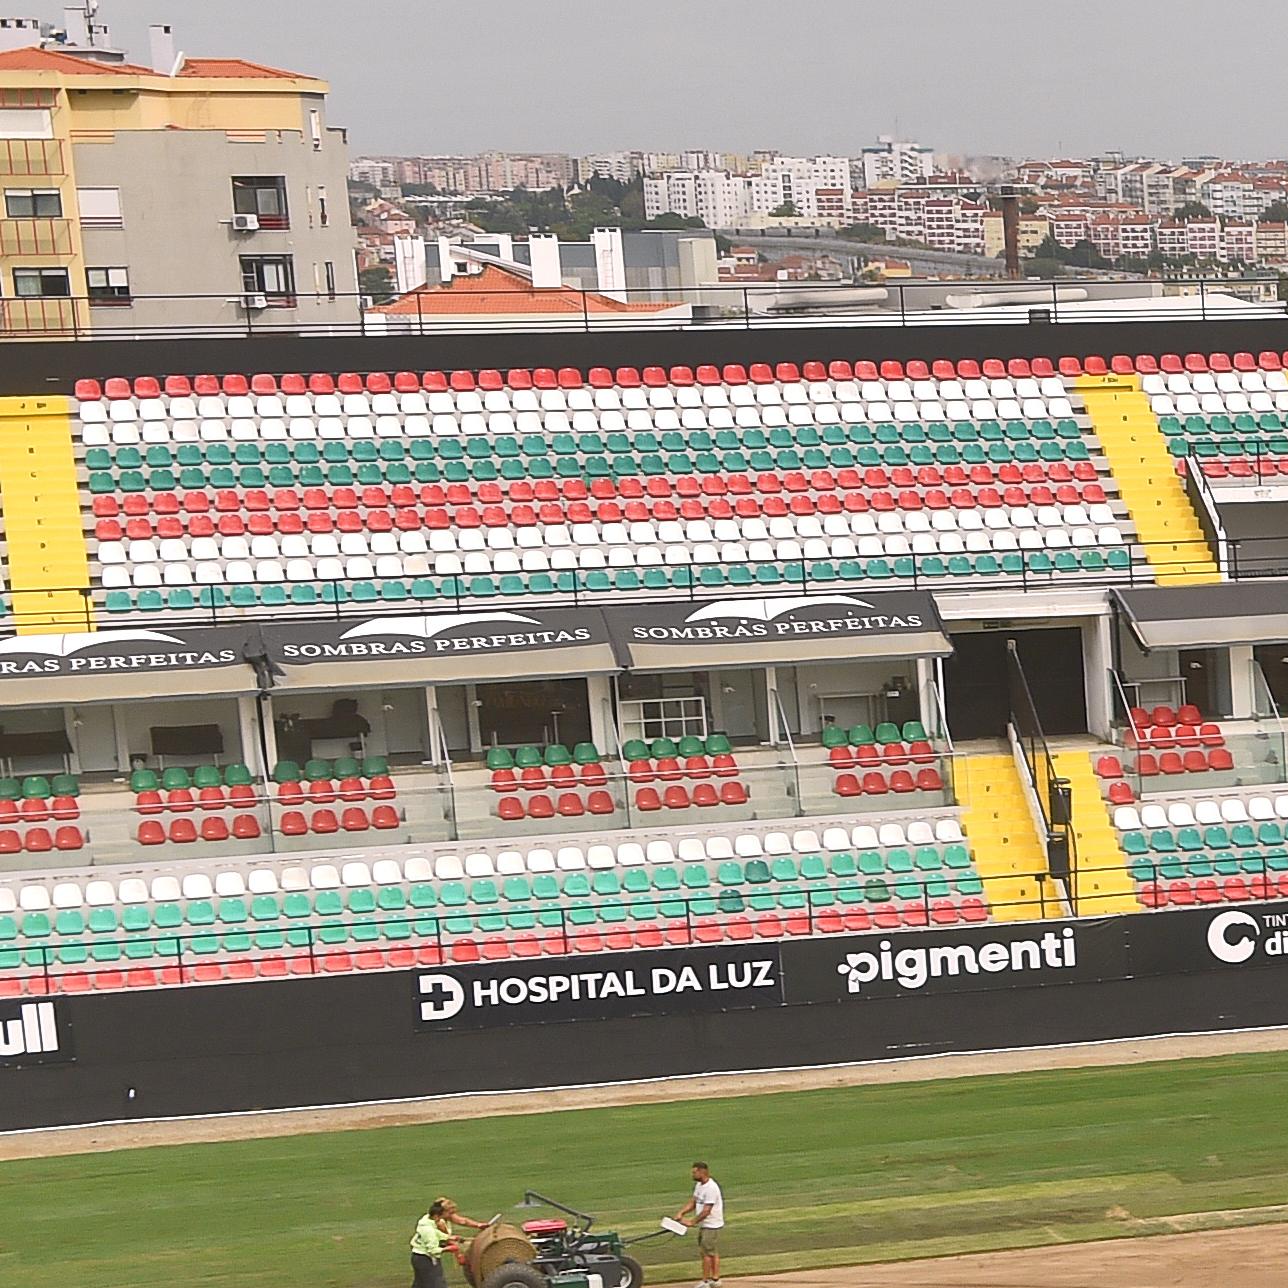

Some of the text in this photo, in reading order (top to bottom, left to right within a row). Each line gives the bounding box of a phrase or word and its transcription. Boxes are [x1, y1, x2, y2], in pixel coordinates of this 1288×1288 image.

[631, 615, 923, 639] SOMBRAS PERFEITAS
[283, 628, 591, 657] SOMBRAS PERFEITAS
[69, 649, 235, 672] PERFEITAS
[837, 926, 1076, 994] pigmenti
[473, 960, 775, 1007] HOSPITAL DA LUZ
